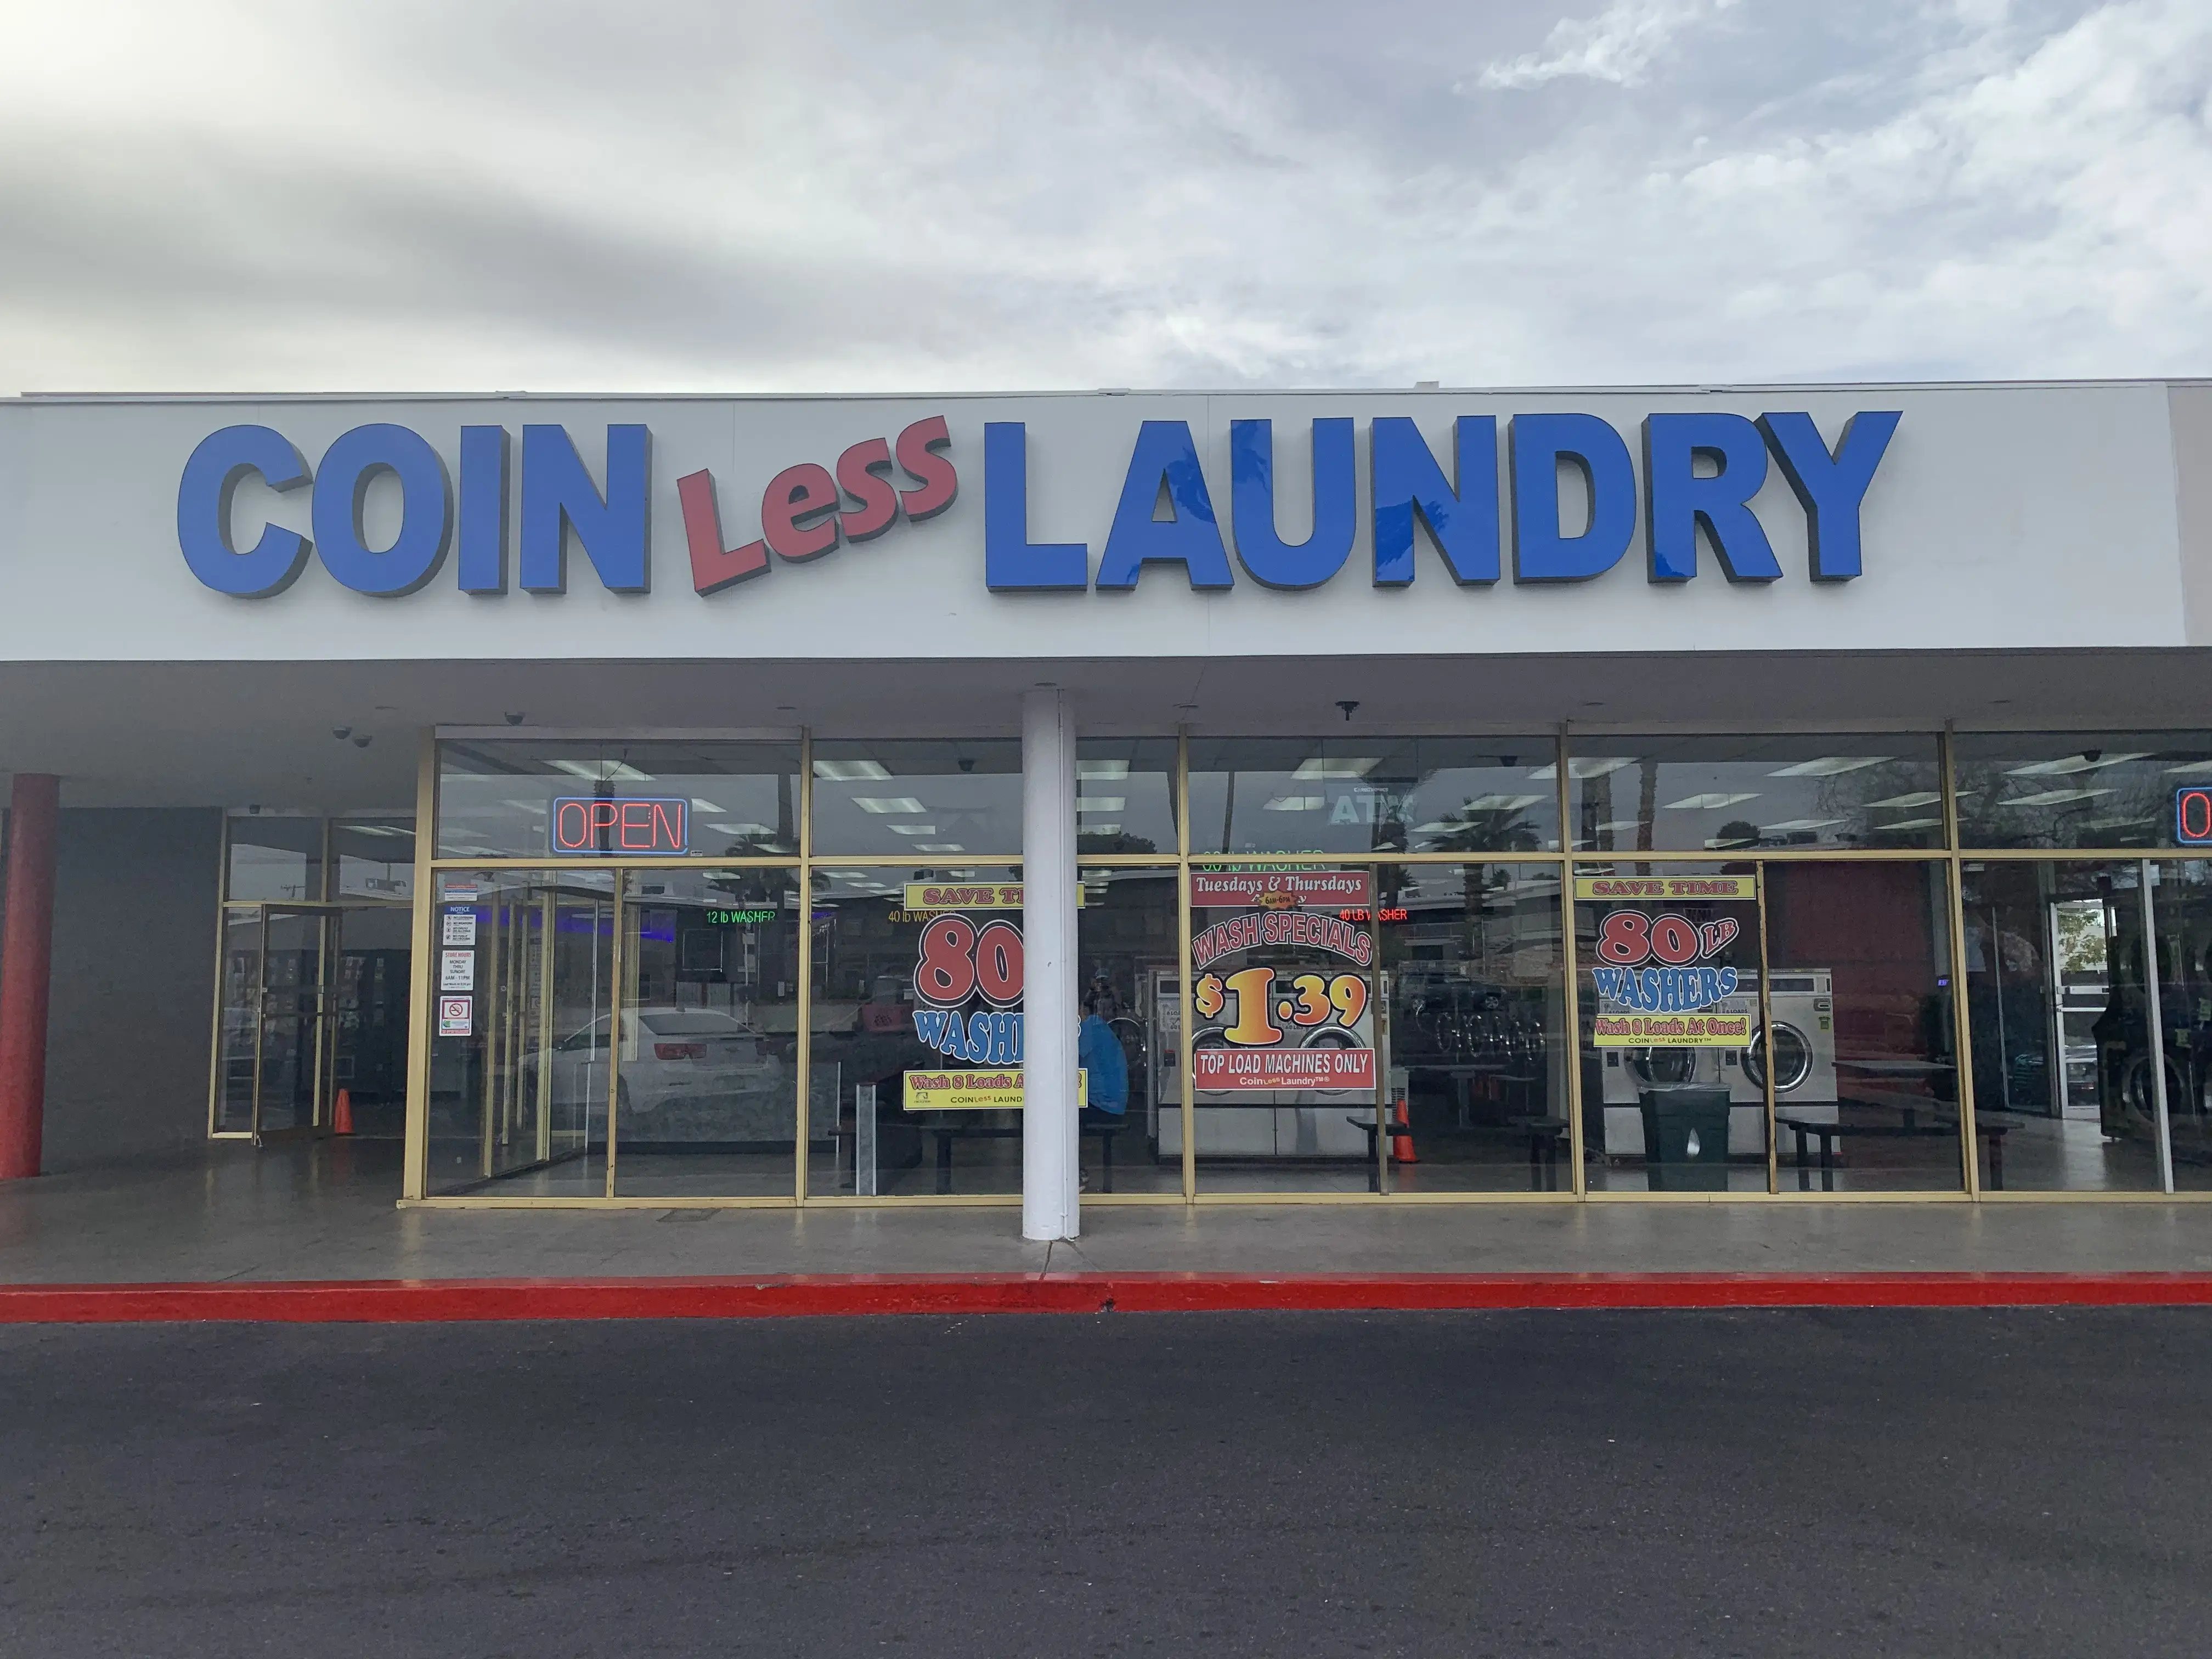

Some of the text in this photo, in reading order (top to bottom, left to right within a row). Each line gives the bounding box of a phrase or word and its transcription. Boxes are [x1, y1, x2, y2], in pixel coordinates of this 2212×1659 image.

[178, 410, 1903, 599] COIN Less LAUNDRY
[559, 803, 682, 849] OPEN
[1196, 876, 1361, 895] Tuesdays & Thursdays
[1593, 881, 1739, 895] SAVE TIME
[923, 888, 1024, 905] SAVE TI
[707, 911, 717, 923] 12
[889, 910, 900, 922] 40
[913, 910, 956, 922] WAS
[1339, 909, 1350, 921] 40
[1352, 909, 1364, 921] LB
[1192, 911, 1372, 970] WASH SPECIALS
[1596, 910, 1740, 967] 80 LB
[913, 913, 1024, 1008] 80
[1592, 967, 1739, 1013] WASHERS
[1195, 967, 1368, 1046] $1.39
[1595, 1017, 1747, 1035] Wash 8 Loads At Once!
[912, 1010, 1025, 1065] WASH
[1200, 1053, 1368, 1074] TOP LOAD MACHINES ONLY
[910, 1074, 950, 1090] Wash
[952, 1075, 964, 1090] 8
[966, 1074, 1011, 1090] Loads
